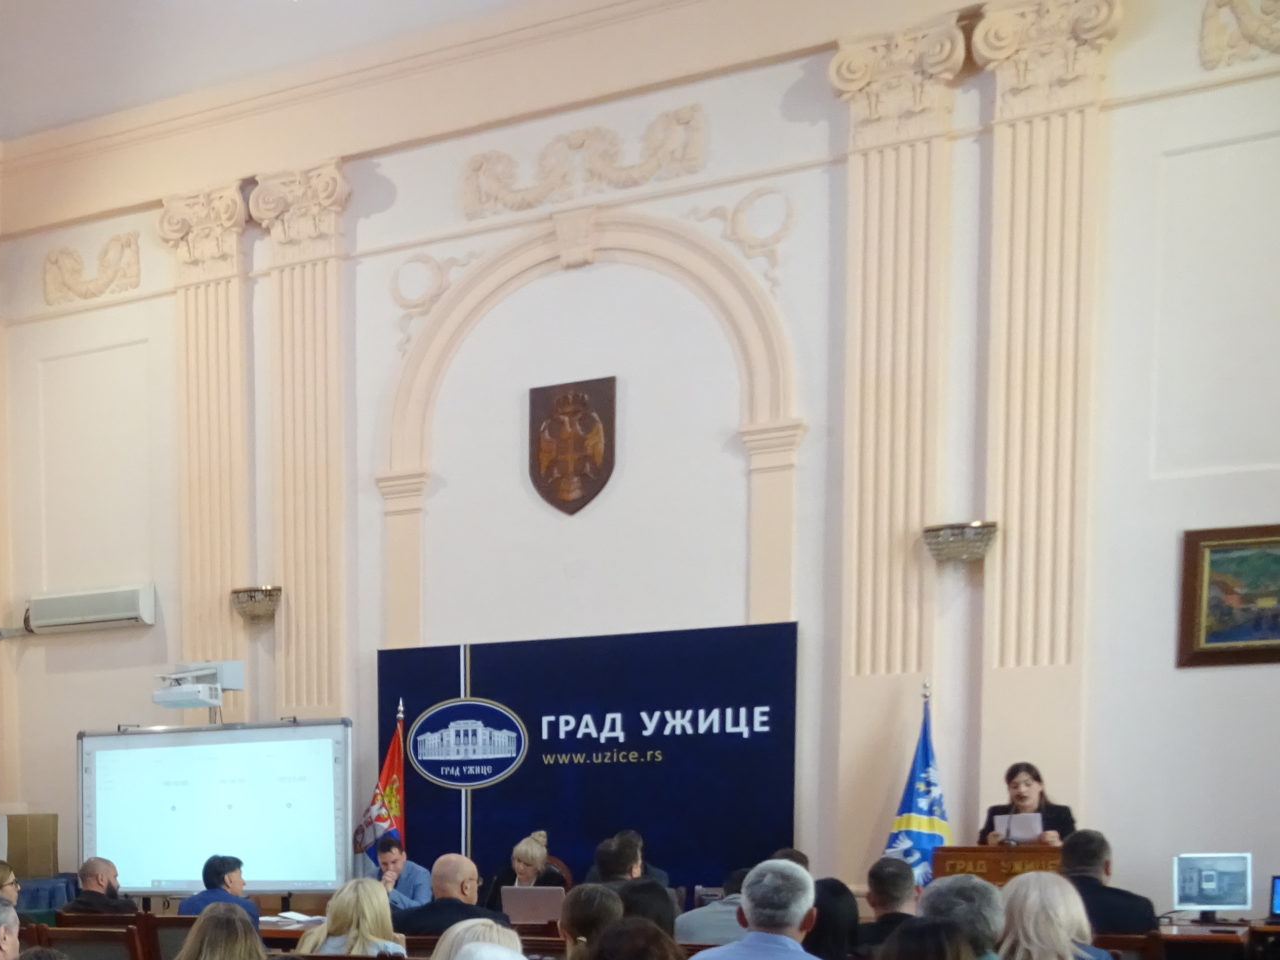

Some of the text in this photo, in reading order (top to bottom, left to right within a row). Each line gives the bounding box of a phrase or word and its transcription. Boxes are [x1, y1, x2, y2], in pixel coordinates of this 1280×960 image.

[541, 705, 771, 744] ГРАД УЖИЦЕ
[542, 748, 664, 765] www.uzice.rs
[440, 766, 460, 777] ГРАД
[945, 860, 988, 873] ГРАД
